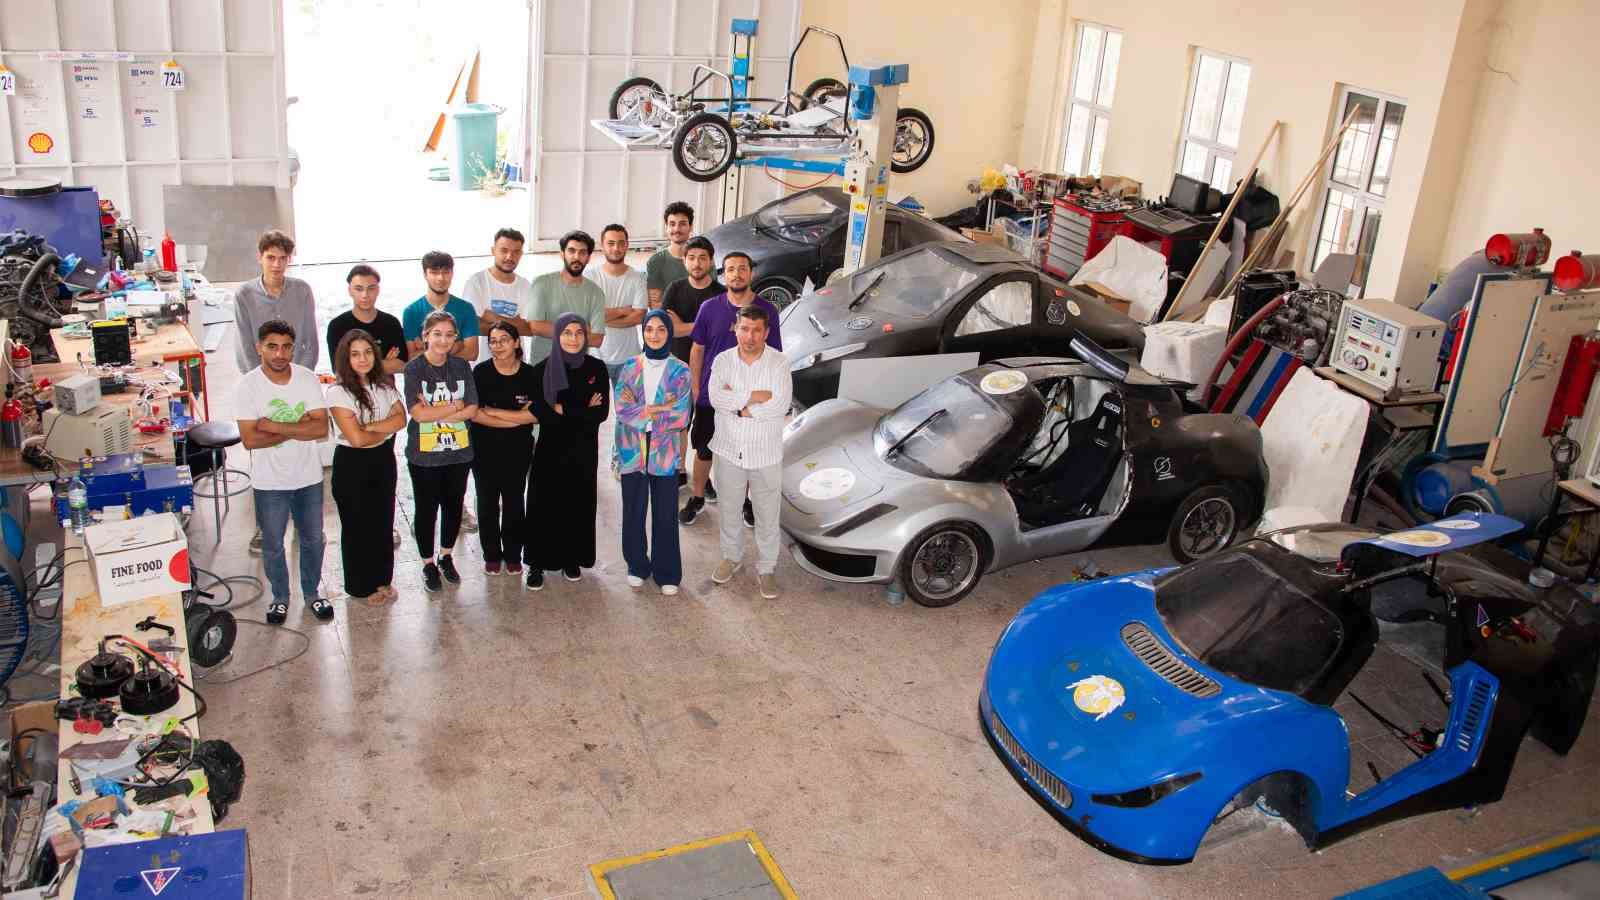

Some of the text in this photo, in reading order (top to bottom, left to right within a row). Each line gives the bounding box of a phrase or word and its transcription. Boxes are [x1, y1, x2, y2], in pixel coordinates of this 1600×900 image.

[163, 71, 182, 87] 724
[111, 560, 163, 578] FINE FOOD
